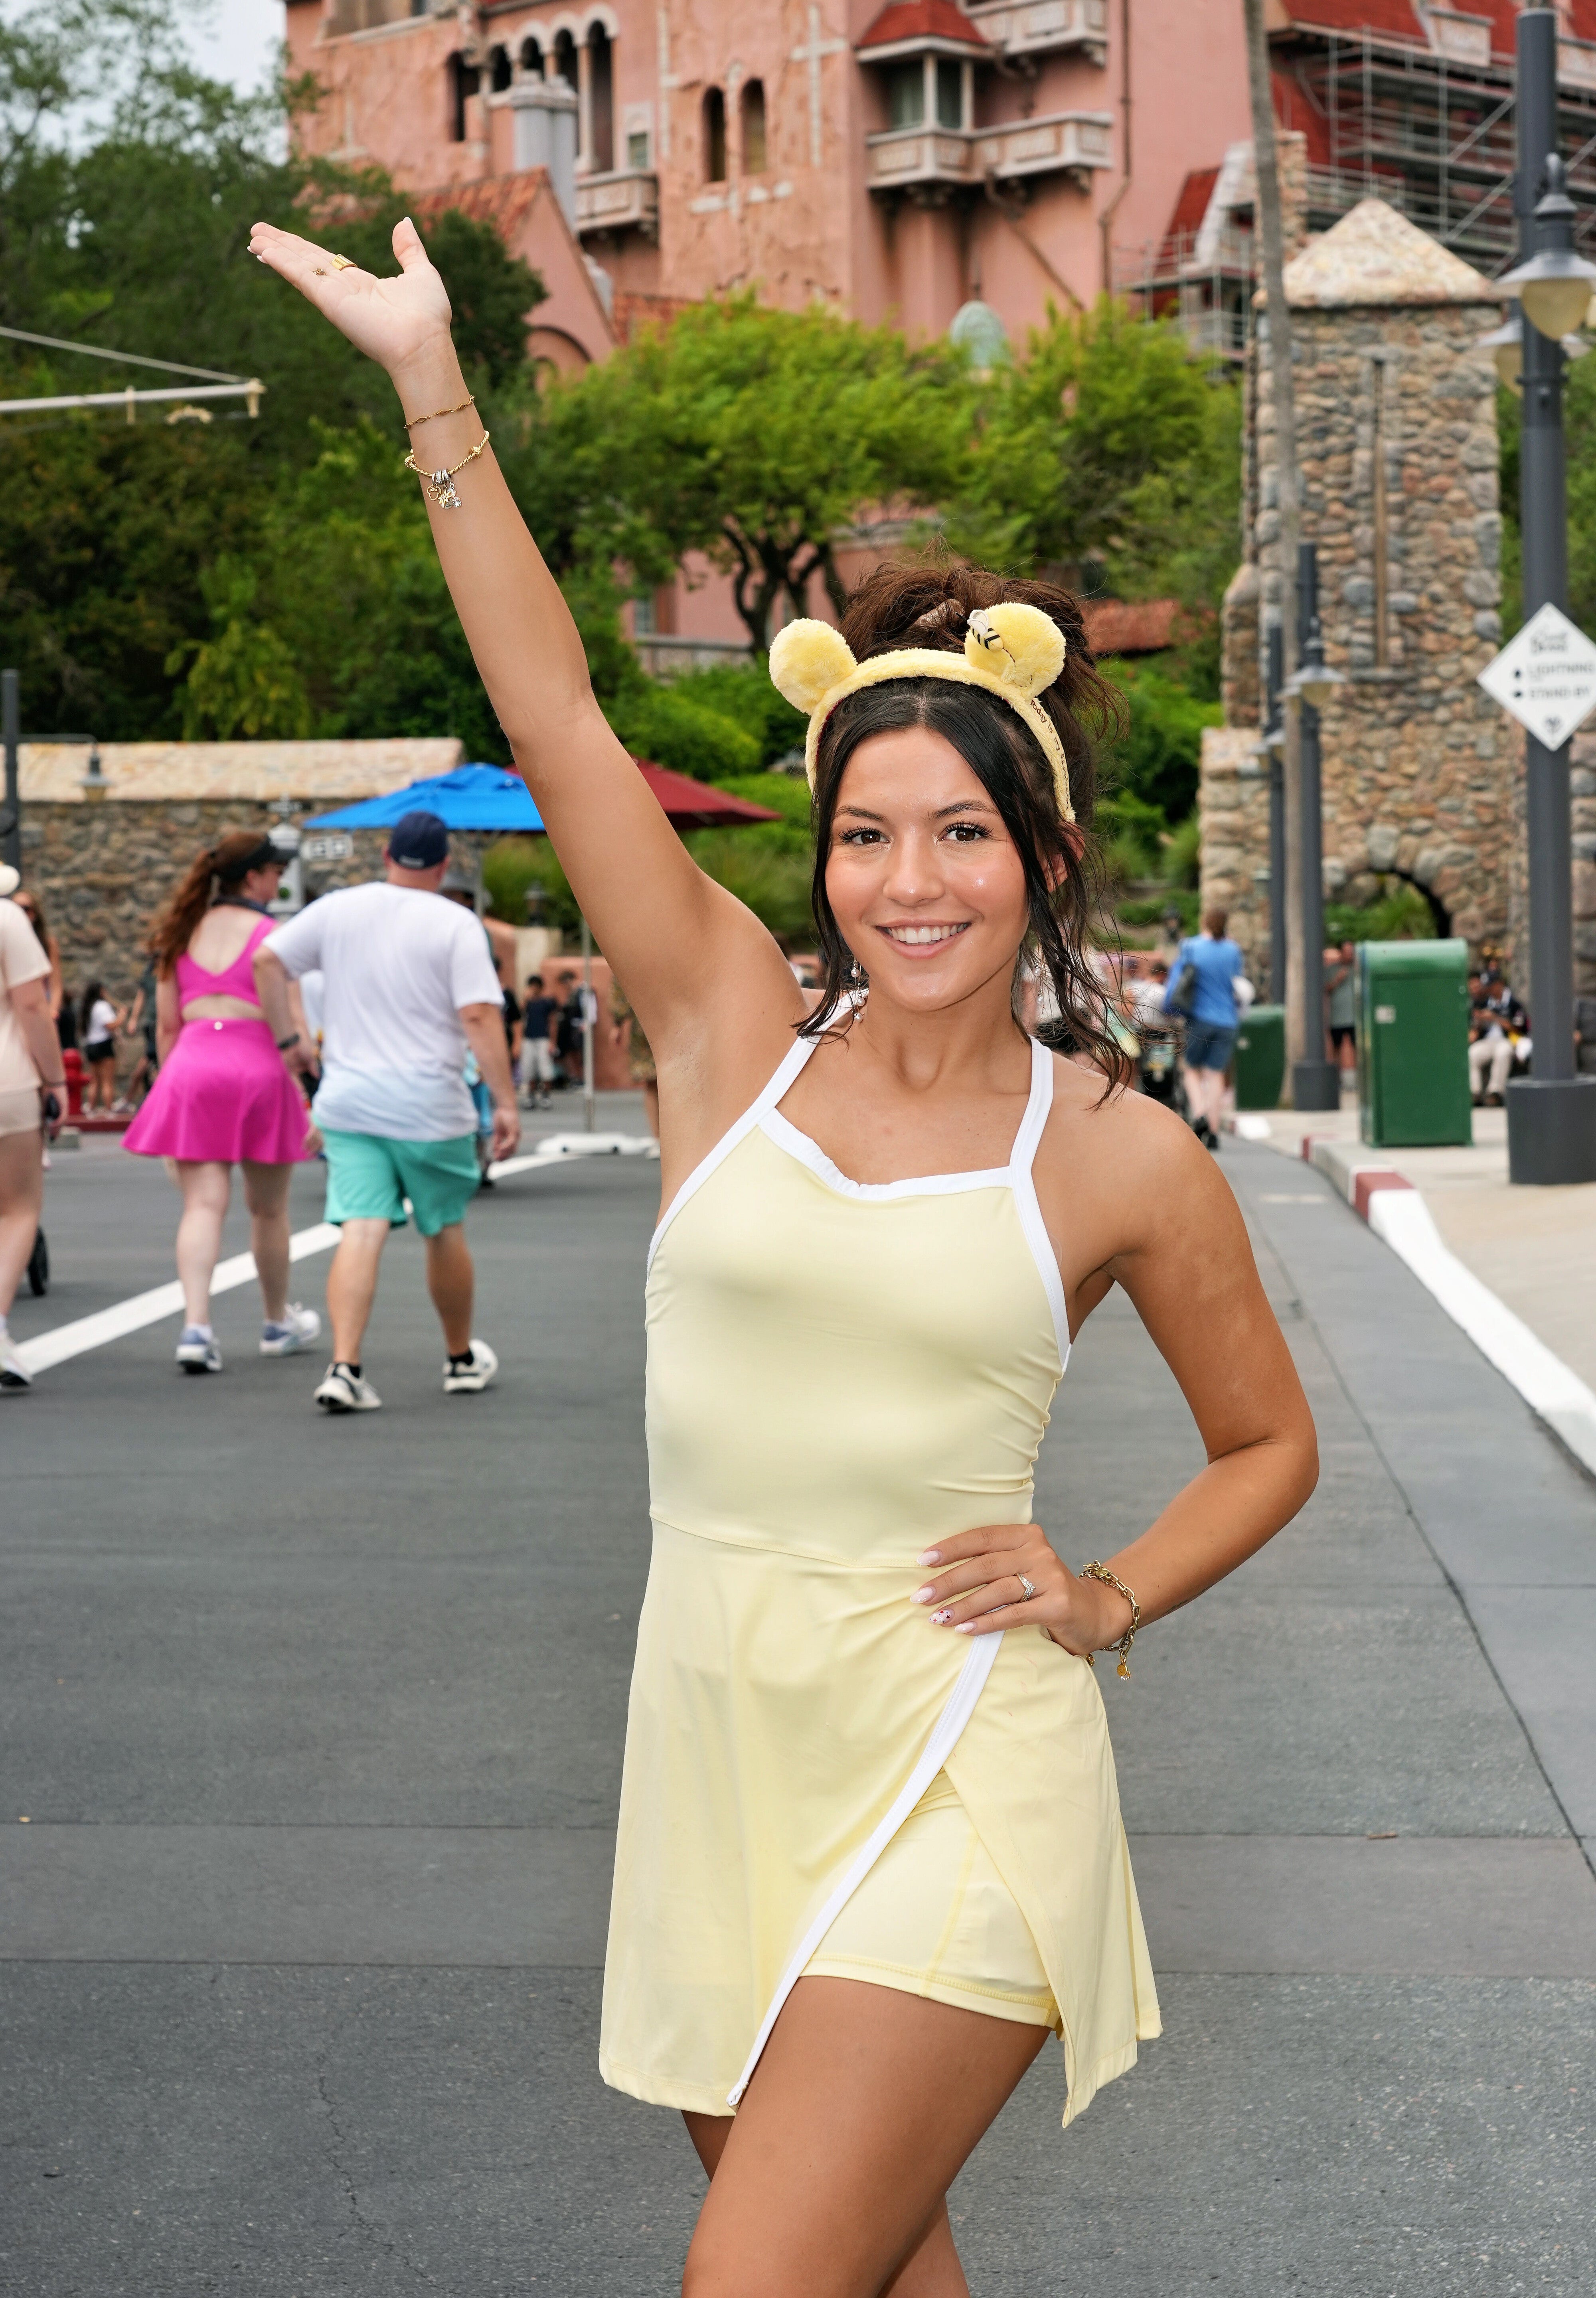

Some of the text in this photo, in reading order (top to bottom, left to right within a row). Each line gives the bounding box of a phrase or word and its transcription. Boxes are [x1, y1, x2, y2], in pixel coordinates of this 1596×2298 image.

[1030, 699, 1047, 723] Today
[1048, 722, 1053, 734] is
[1054, 736, 1060, 751] my
